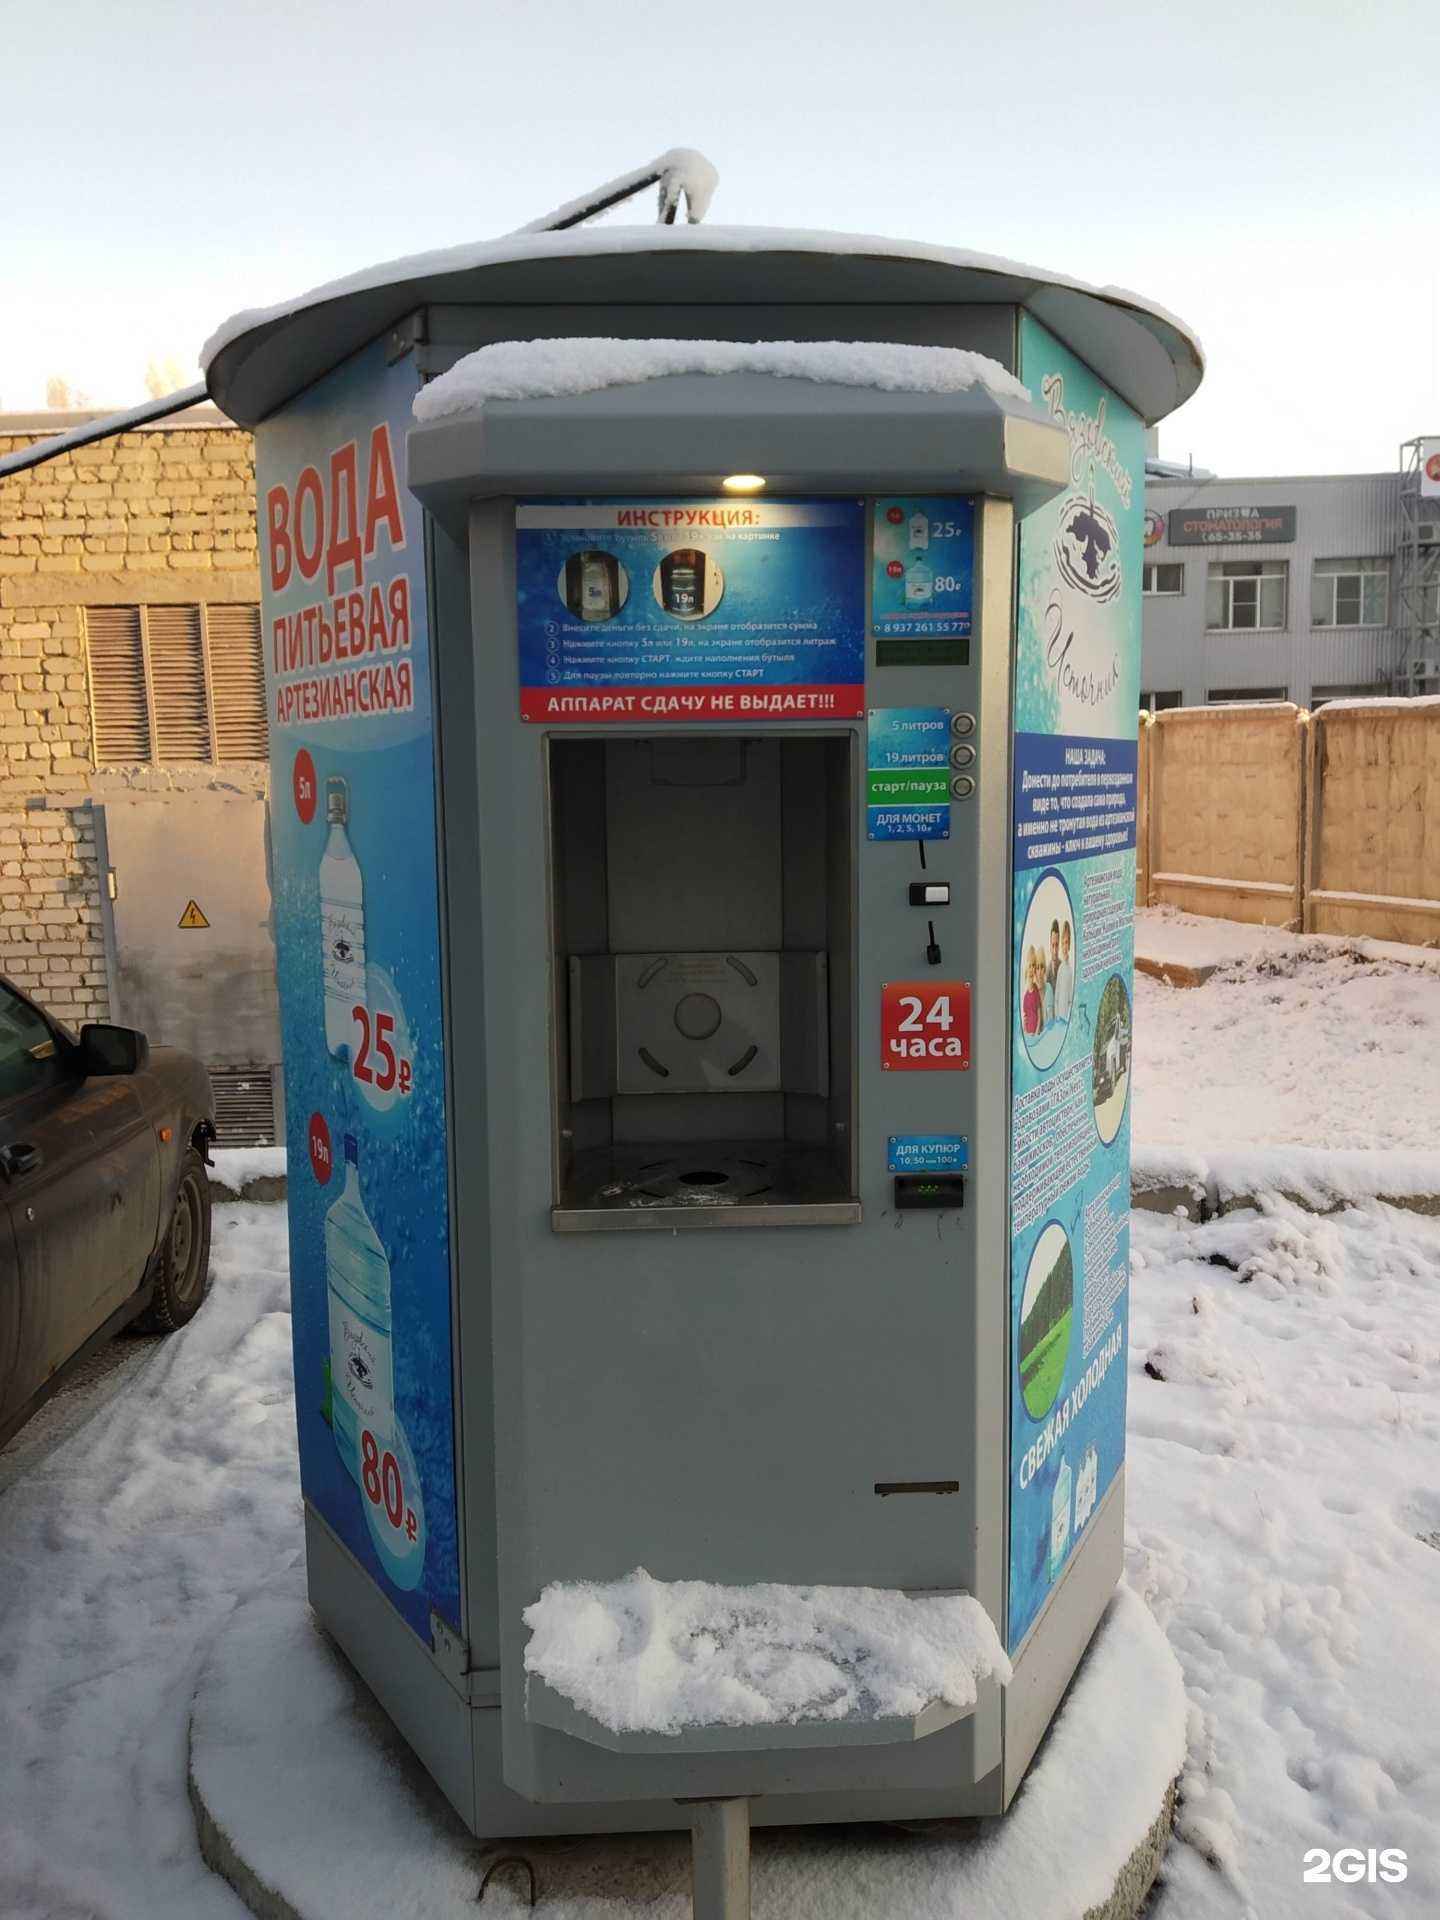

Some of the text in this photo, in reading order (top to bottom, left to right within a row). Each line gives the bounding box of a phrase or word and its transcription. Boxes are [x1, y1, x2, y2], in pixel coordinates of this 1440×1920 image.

[266, 421, 406, 596] ВОДА
[617, 509, 761, 528] ИНСТРУКЦИЯ:
[1184, 517, 1283, 533] СТОМАТОЛОГИЯ
[675, 593, 695, 604] 19л
[272, 575, 411, 675] ПИТЬЕВАЯ
[635, 622, 651, 632] без
[788, 622, 818, 633] сумма
[884, 623, 891, 633] 8
[892, 623, 912, 633] 937
[915, 622, 933, 632] 261
[936, 622, 949, 632] 55
[701, 670, 733, 680] кнопку
[735, 668, 764, 679] СТАРТ
[277, 662, 413, 724] АРТЕЗИАНСКАЯ
[547, 693, 835, 713] АППАРАТ СДАЧУ НЕ ВЫДАЕТ!!!
[891, 721, 944, 732] 5 литров
[886, 752, 944, 764] 19 литров
[1065, 748, 1083, 765] НАША
[299, 777, 311, 799] 5л
[872, 780, 947, 794] старт/пауза
[1022, 770, 1051, 793] Донести
[1052, 774, 1060, 791] до
[1061, 796, 1071, 809] что
[877, 813, 942, 826] ДЛЯ МОНЕТ
[888, 824, 894, 833] 1,
[897, 824, 905, 833] 2,
[1018, 824, 1022, 837] а
[1023, 821, 1049, 837] именно
[1050, 820, 1058, 833] не
[1028, 841, 1061, 859] скважины
[898, 996, 954, 1032] 24
[889, 1036, 963, 1058] часа
[312, 1134, 329, 1165] 19л
[896, 1144, 961, 1156] ДЛЯ КУПЮР
[1019, 1399, 1070, 1490] СВЕЖАЯ
[1071, 1324, 1122, 1419] ХОЛОДНАЯ
[362, 1430, 420, 1544] 80₽
